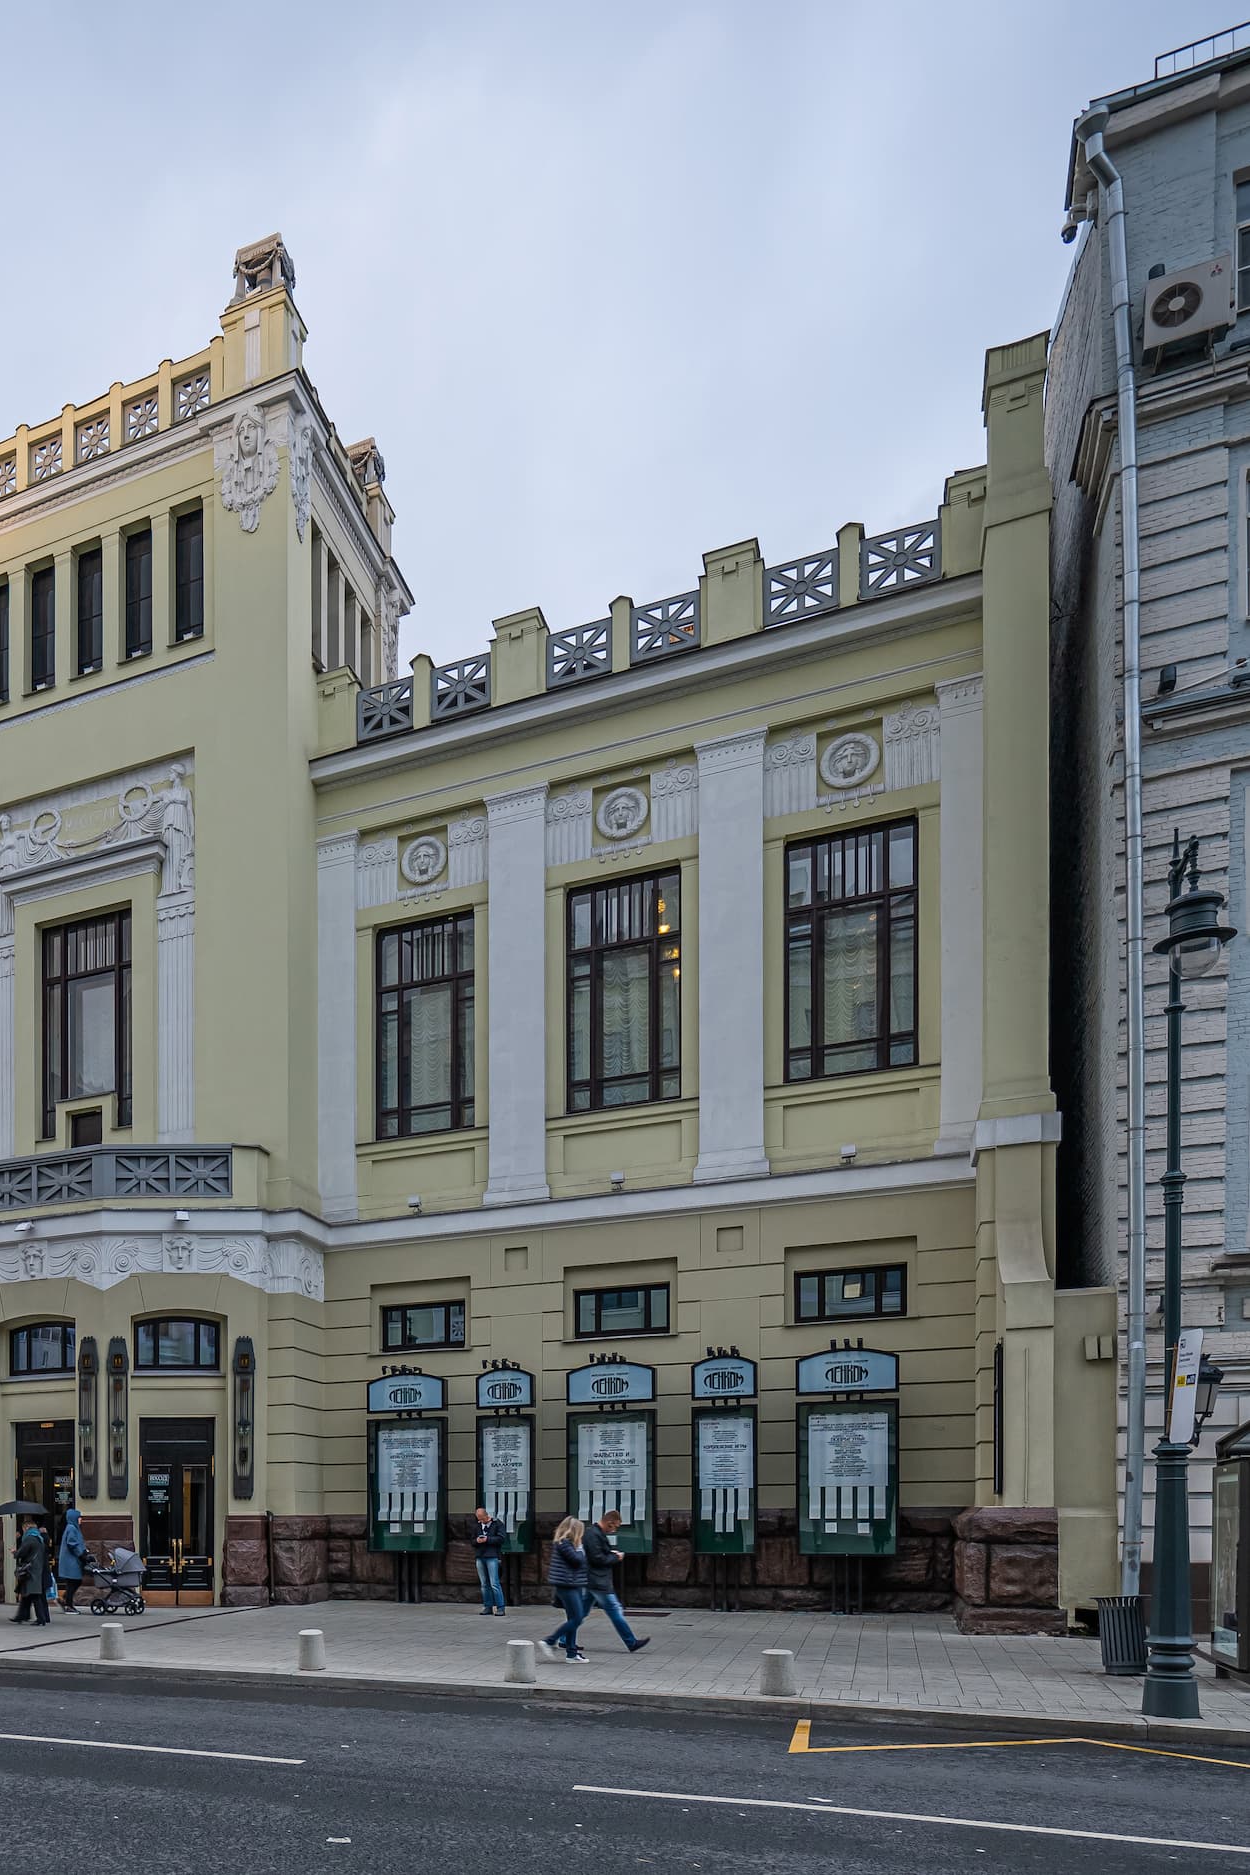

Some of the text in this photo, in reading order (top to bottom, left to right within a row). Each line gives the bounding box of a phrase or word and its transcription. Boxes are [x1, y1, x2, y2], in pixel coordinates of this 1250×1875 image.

[703, 1371, 744, 1390] ЛЕНКОМ
[825, 1364, 869, 1384] ЛЕНКОМ
[487, 1382, 522, 1400] ЛЕНКОМ
[591, 1377, 629, 1395] ЛЕНКОМ
[389, 1387, 422, 1404] ЛЕНКОМ
